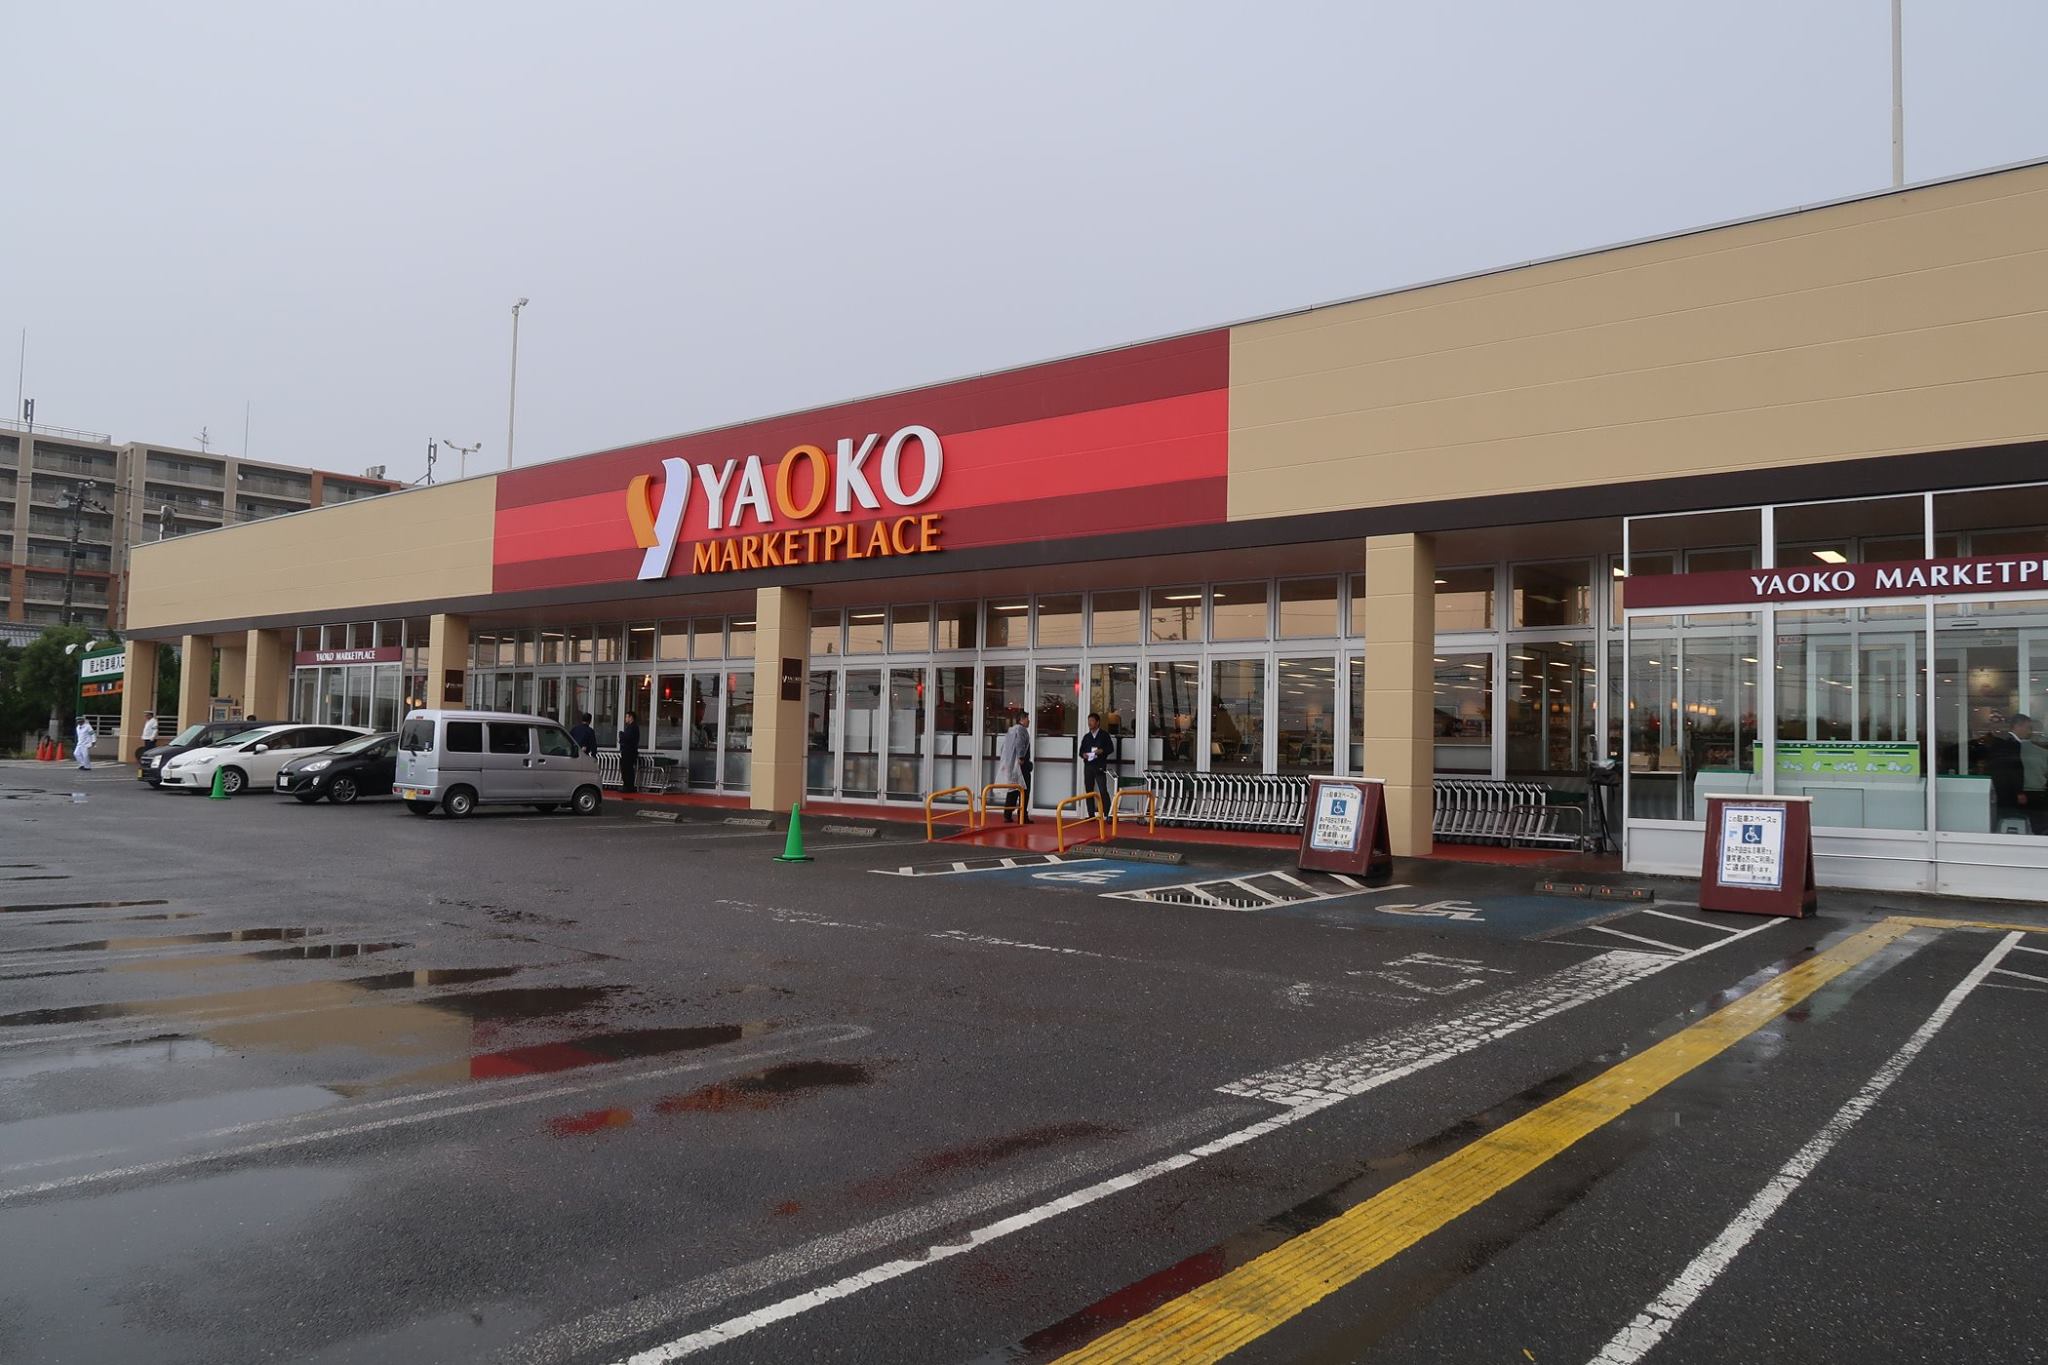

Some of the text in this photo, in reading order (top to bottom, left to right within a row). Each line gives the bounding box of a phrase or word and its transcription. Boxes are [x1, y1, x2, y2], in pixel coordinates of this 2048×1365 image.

[696, 424, 944, 529] YAOKO
[693, 513, 943, 575] MARKETPLACE
[1750, 570, 1856, 595] YAOKO
[316, 650, 376, 662] YAOKO MARKETPLACE
